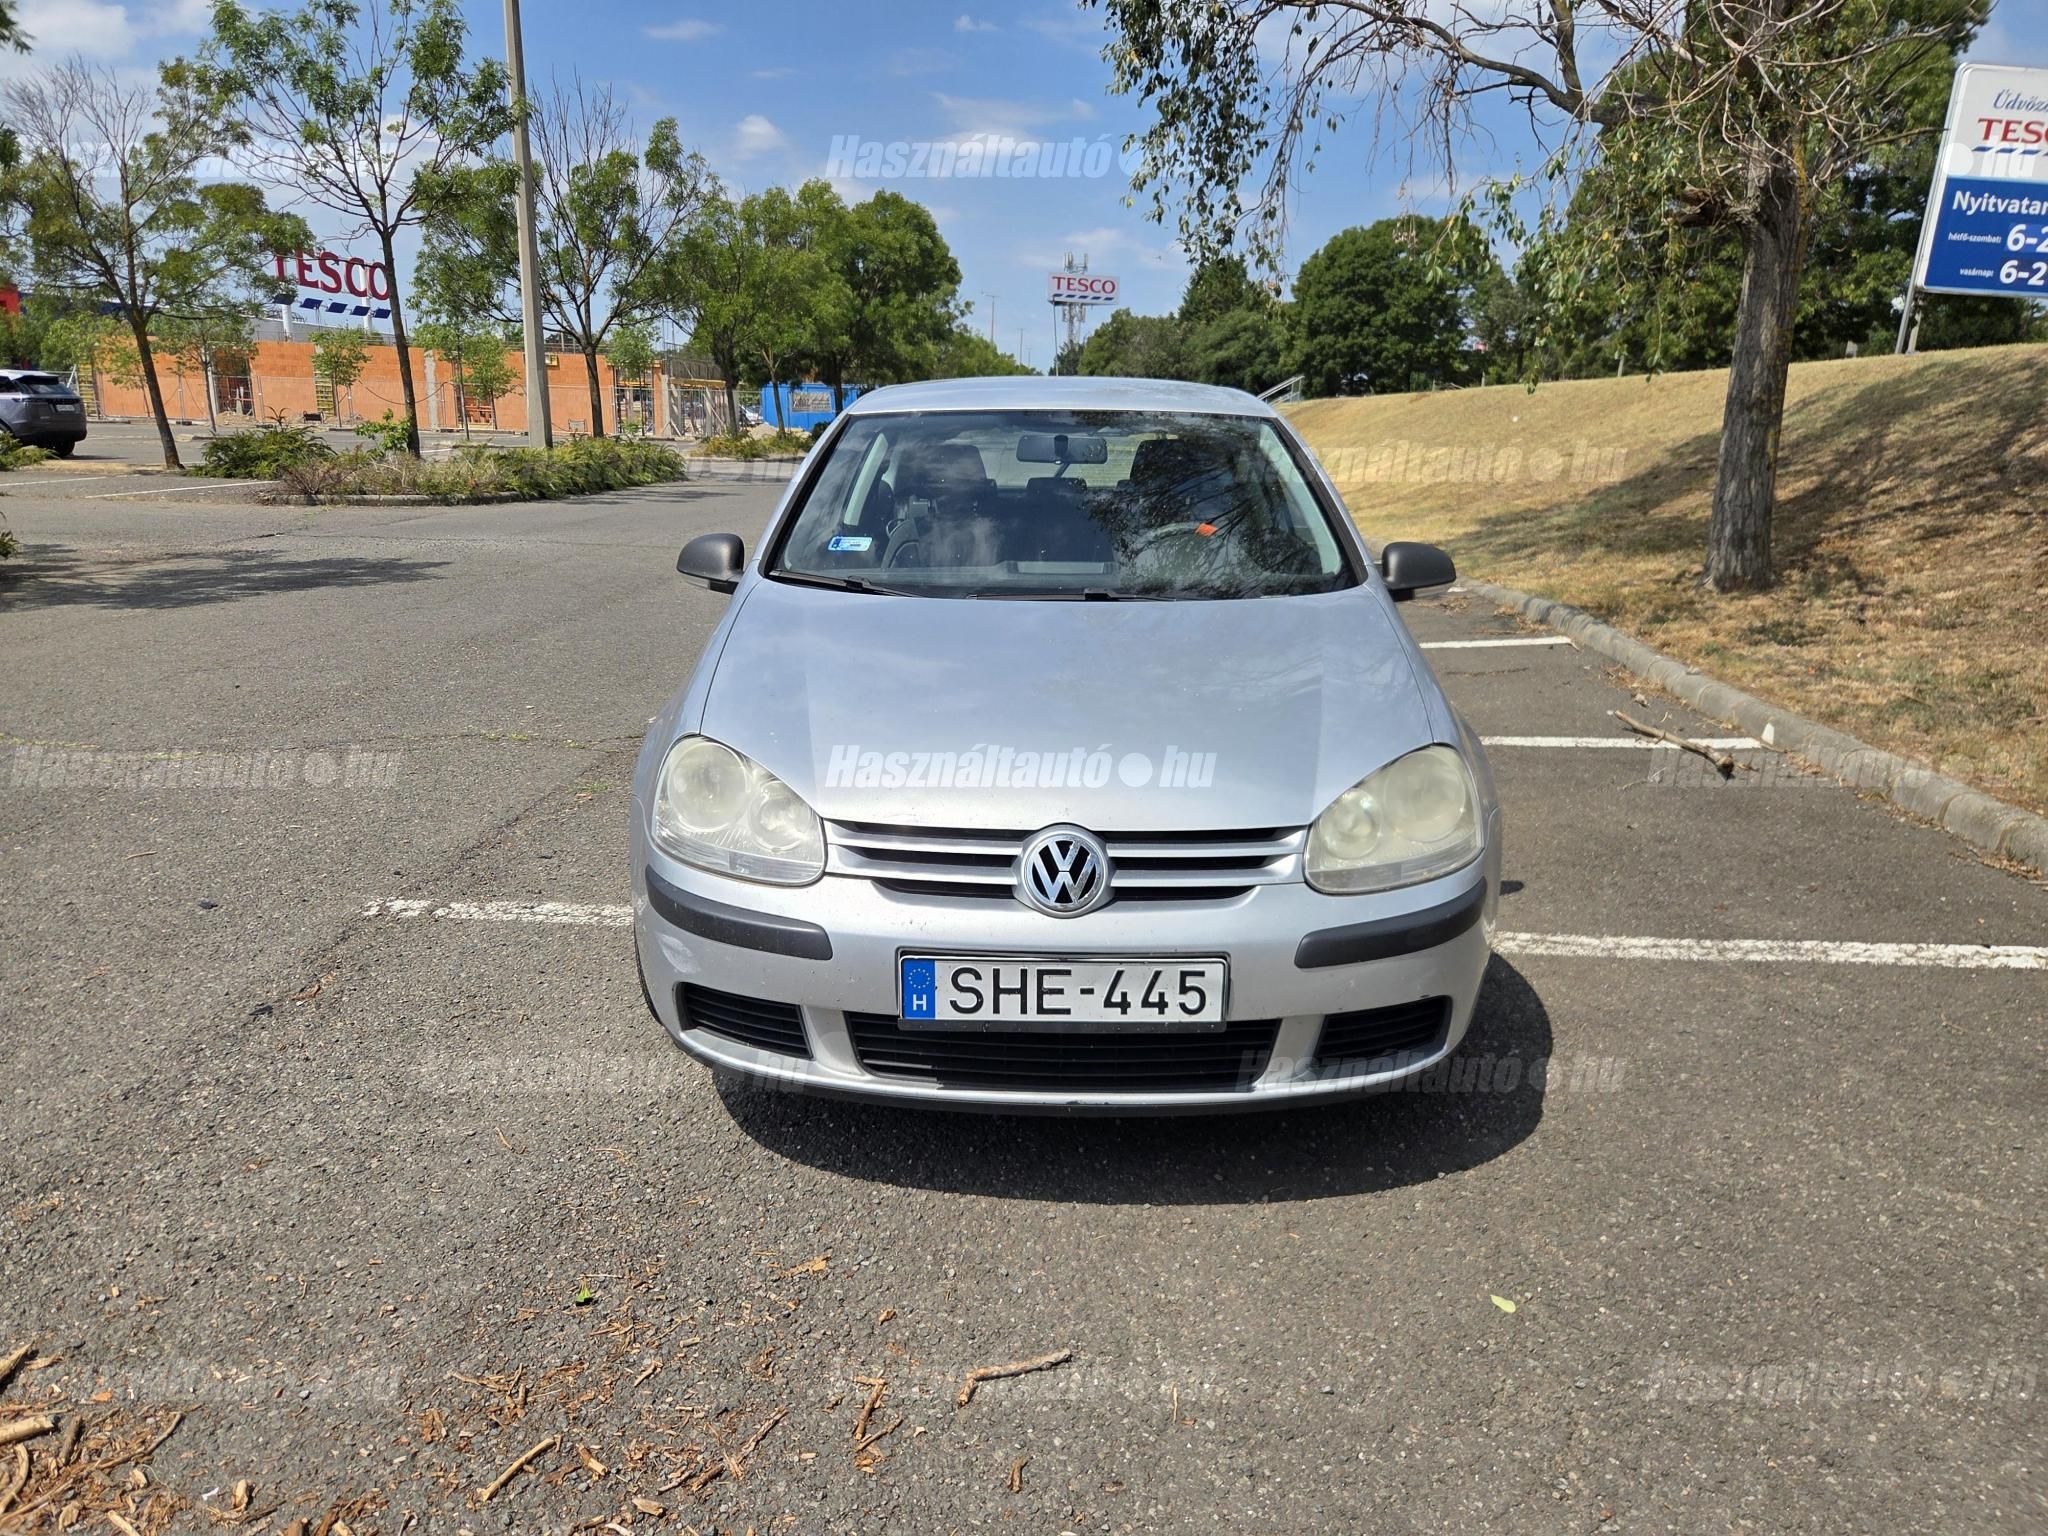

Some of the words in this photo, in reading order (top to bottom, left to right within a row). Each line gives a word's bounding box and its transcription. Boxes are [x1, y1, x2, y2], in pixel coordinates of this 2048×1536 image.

[1052, 275, 1116, 295] TESCO
[912, 994, 927, 1011] H
[949, 967, 1207, 1016] SHE-445
